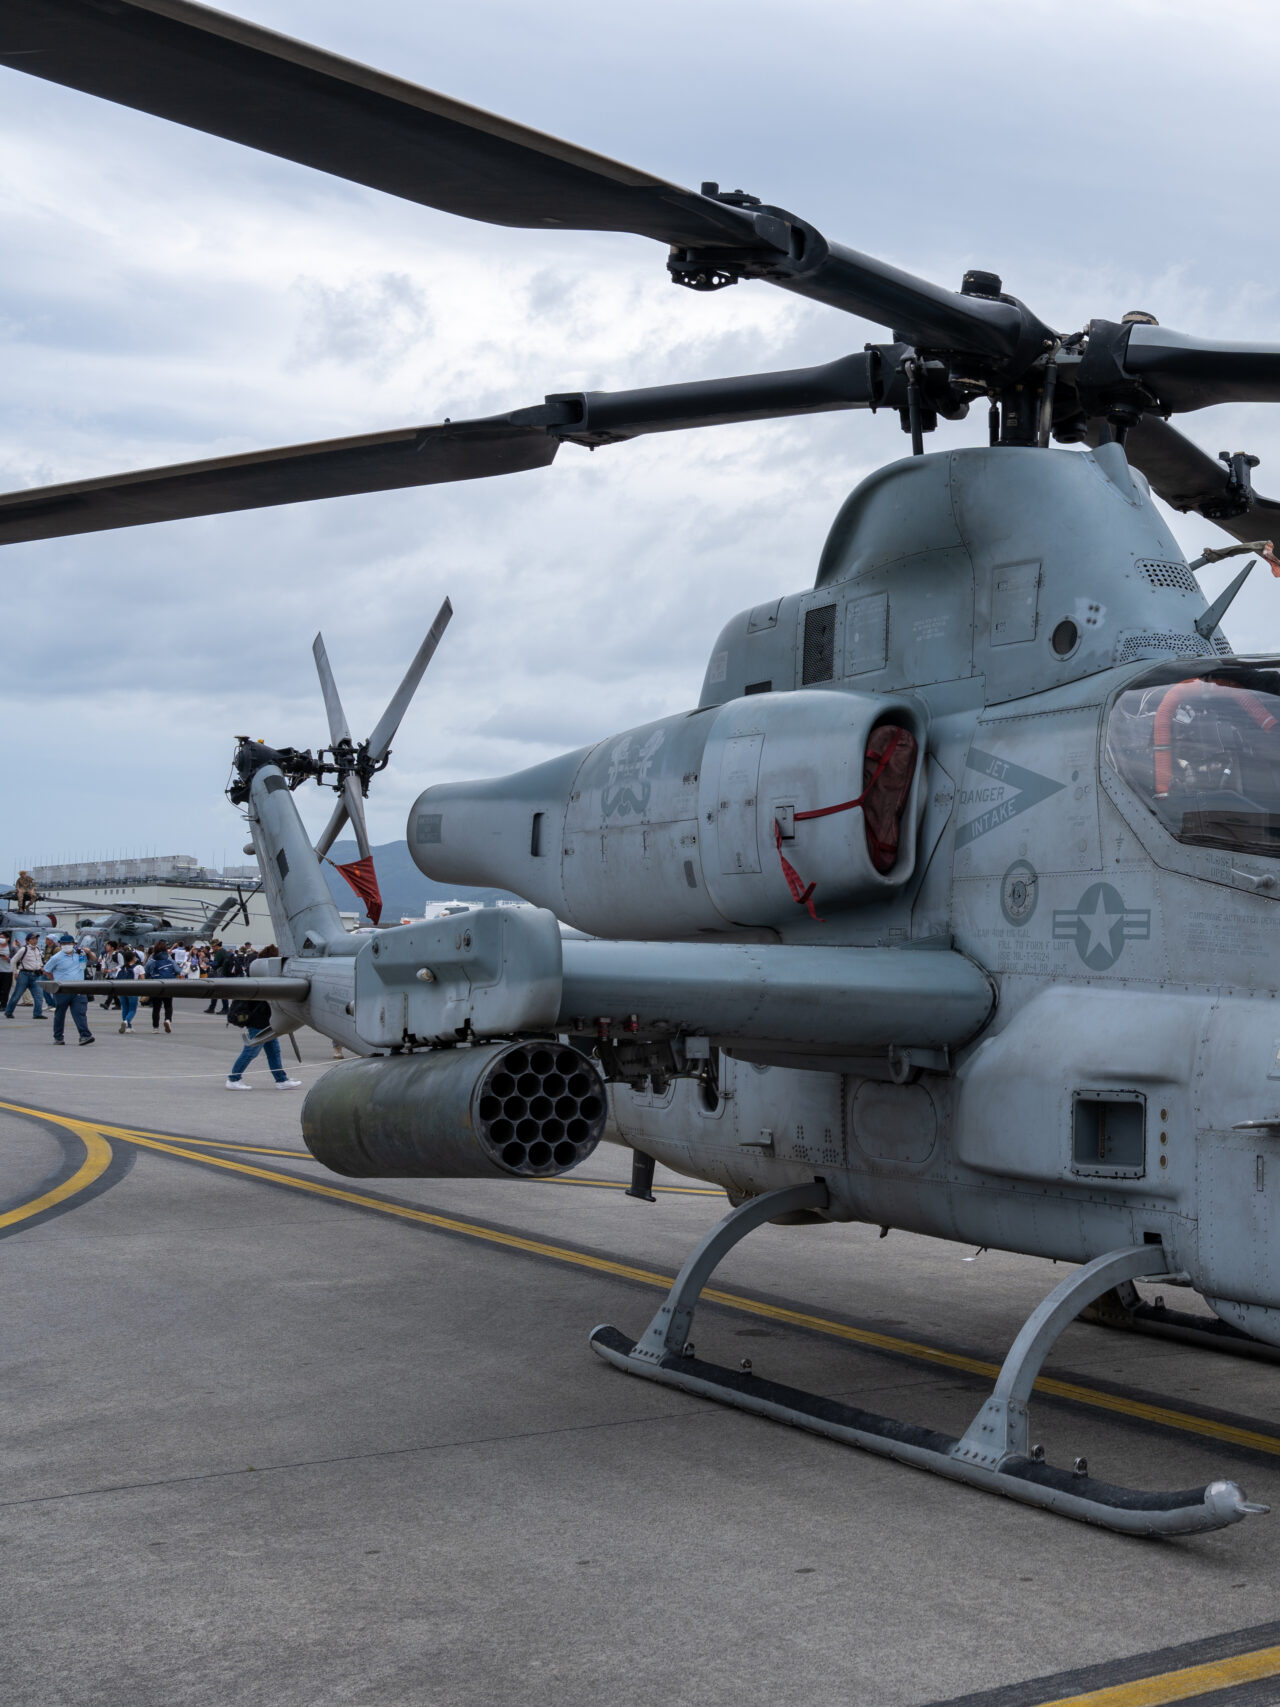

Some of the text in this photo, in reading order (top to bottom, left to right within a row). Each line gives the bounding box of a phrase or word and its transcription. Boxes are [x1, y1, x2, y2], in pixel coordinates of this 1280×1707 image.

[986, 760, 1010, 779] JET
[961, 786, 1005, 804] DANGER
[971, 799, 1017, 838] INTAKE
